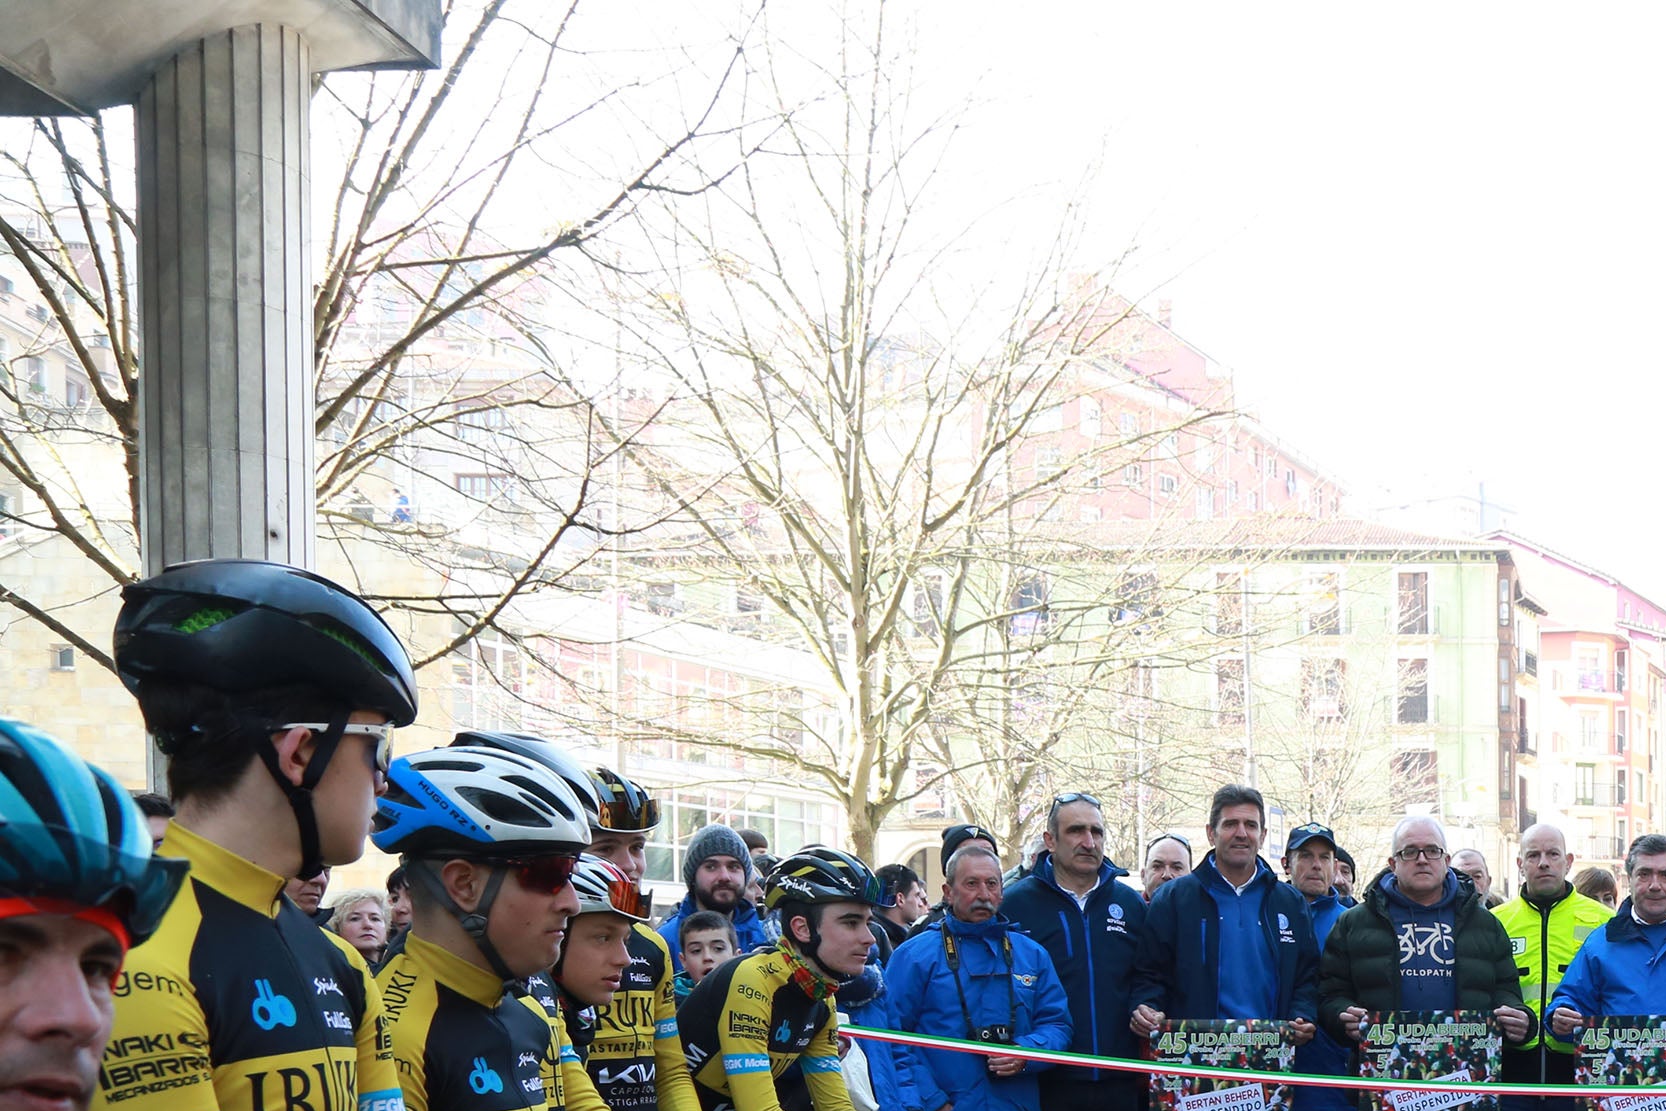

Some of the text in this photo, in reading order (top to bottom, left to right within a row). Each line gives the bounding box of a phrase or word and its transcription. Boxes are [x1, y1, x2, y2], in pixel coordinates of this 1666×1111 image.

[417, 781, 468, 827] HUGO RZ
[777, 874, 816, 898] Spiuk
[1400, 968, 1453, 978] YCLOPATH
[1158, 1032, 1280, 1055] 45 UDABERRI
[1367, 1023, 1487, 1046] 45 UDABERRI
[1581, 1028, 1610, 1050] 45
[1377, 1055, 1387, 1069] 5
[1592, 1059, 1603, 1075] 5
[1185, 1088, 1261, 1111] BERTAN BEHERA
